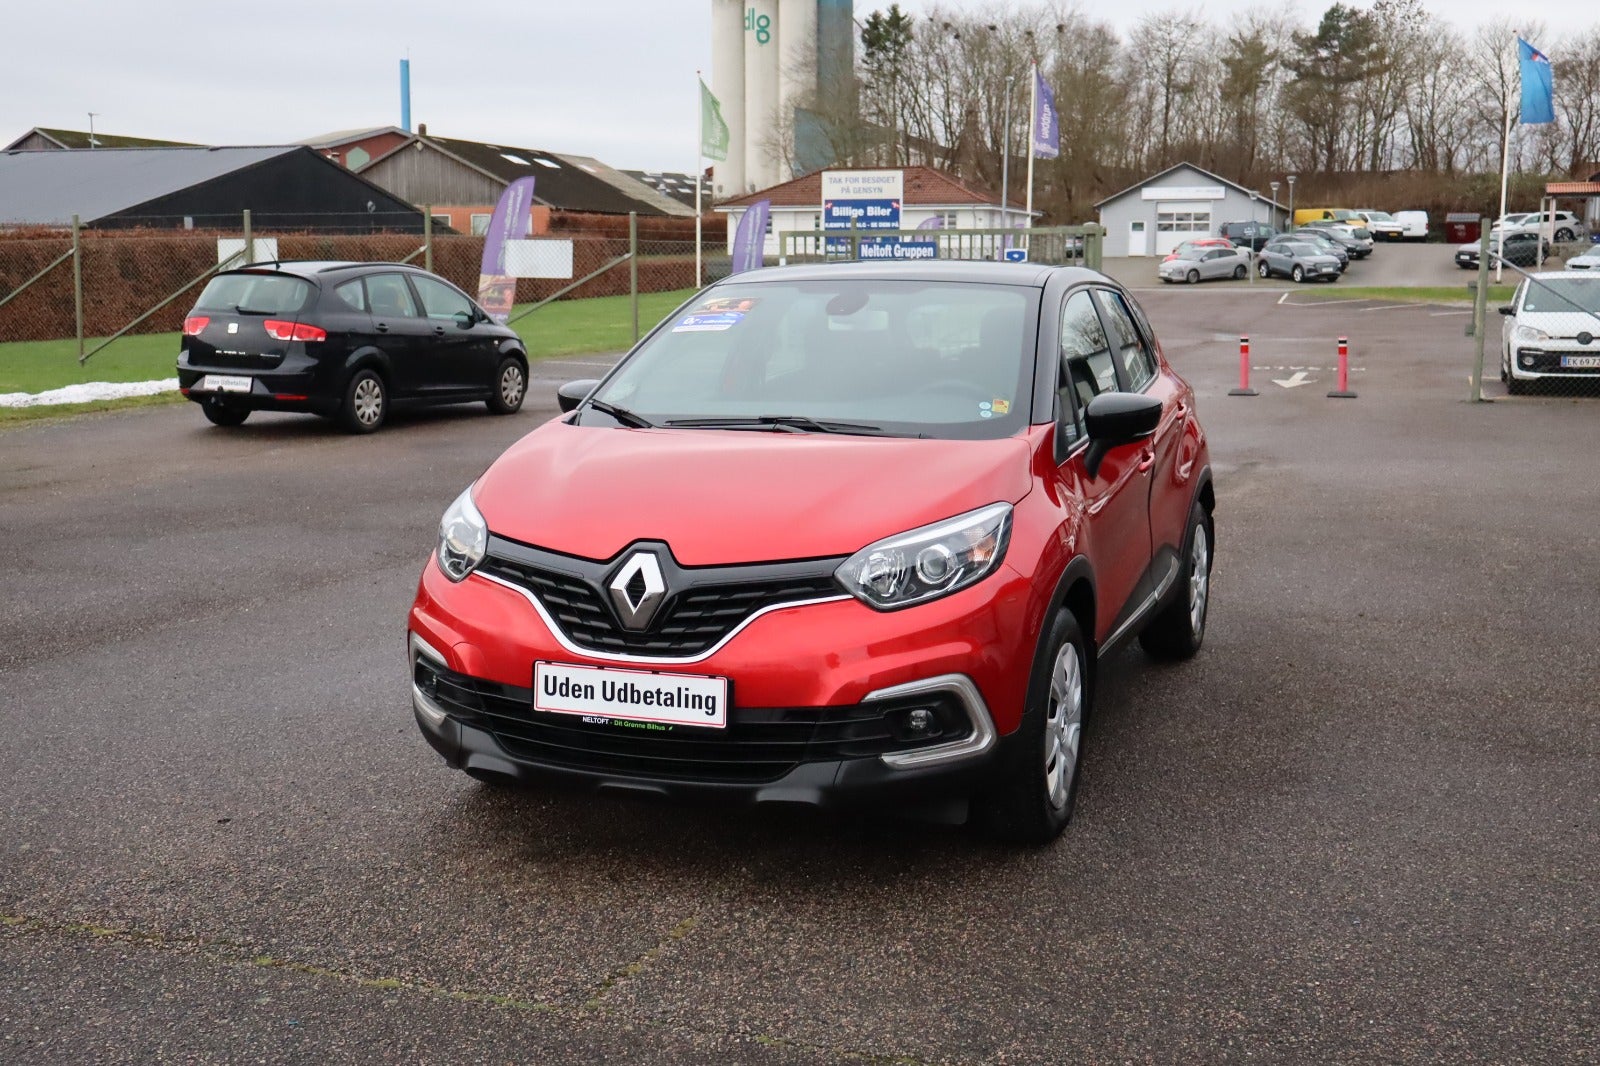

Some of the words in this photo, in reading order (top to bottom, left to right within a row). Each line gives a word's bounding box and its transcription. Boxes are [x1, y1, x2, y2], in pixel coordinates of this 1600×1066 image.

[828, 176, 843, 184] TAK
[845, 176, 860, 184] FOR
[853, 186, 883, 194] GENSYN
[832, 206, 864, 217] Billige
[866, 206, 892, 216] Biler
[860, 244, 892, 257] Neltoft
[893, 243, 934, 259] Gruppen
[544, 674, 595, 700] Uden
[602, 680, 717, 716] Udbetaling
[582, 716, 609, 725] NELTOFT
